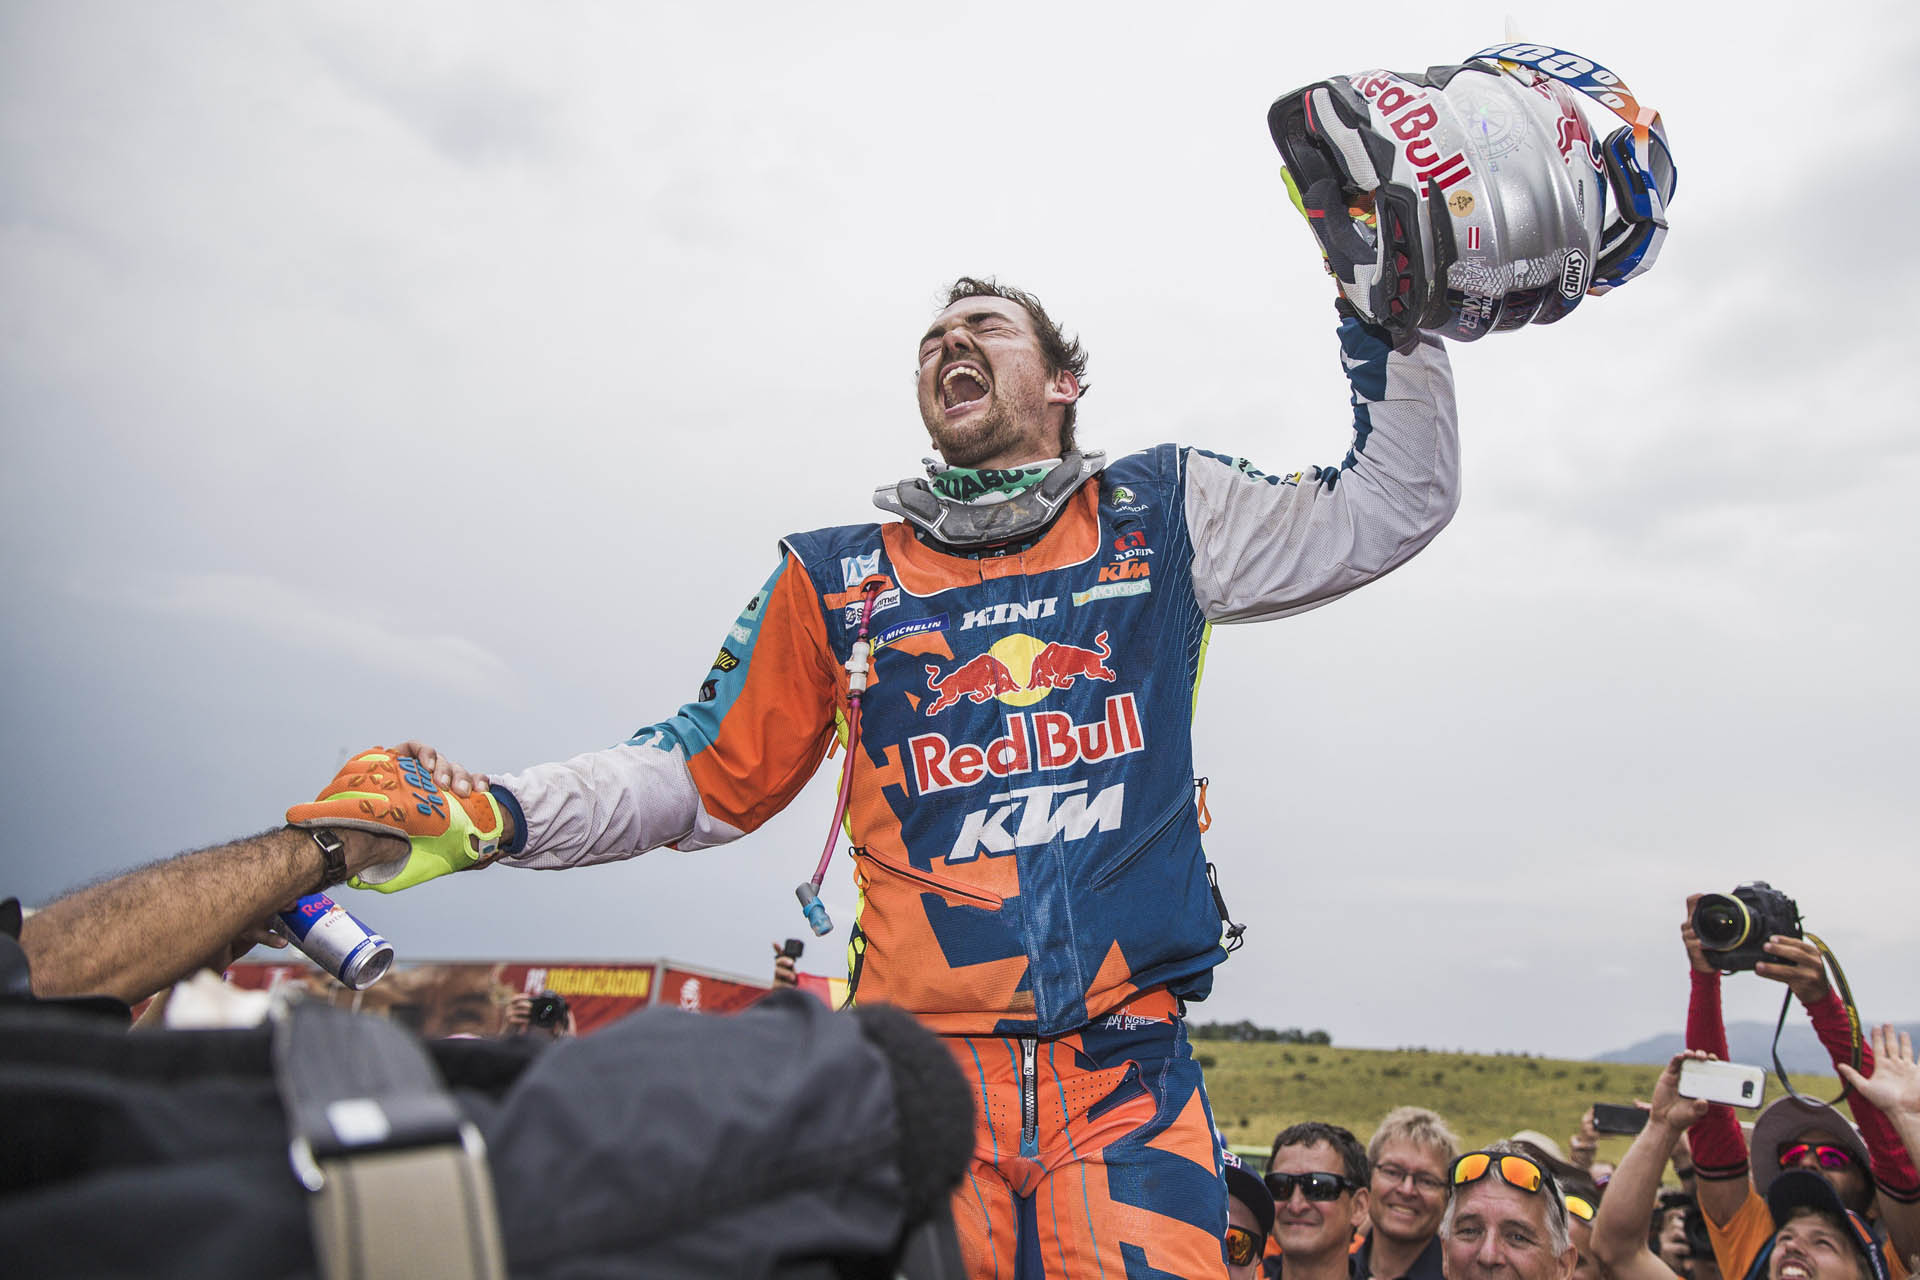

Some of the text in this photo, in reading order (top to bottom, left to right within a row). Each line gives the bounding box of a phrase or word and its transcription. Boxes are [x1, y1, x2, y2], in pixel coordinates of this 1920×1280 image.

[1390, 103, 1472, 198] Bull
[1564, 256, 1582, 293] SHOEI
[1098, 558, 1151, 582] KTM
[886, 621, 942, 640] MICHELIN
[960, 597, 1058, 631] KINI
[908, 693, 1145, 796] Red Bull
[949, 780, 1124, 860] KTM
[301, 896, 334, 917] Red
